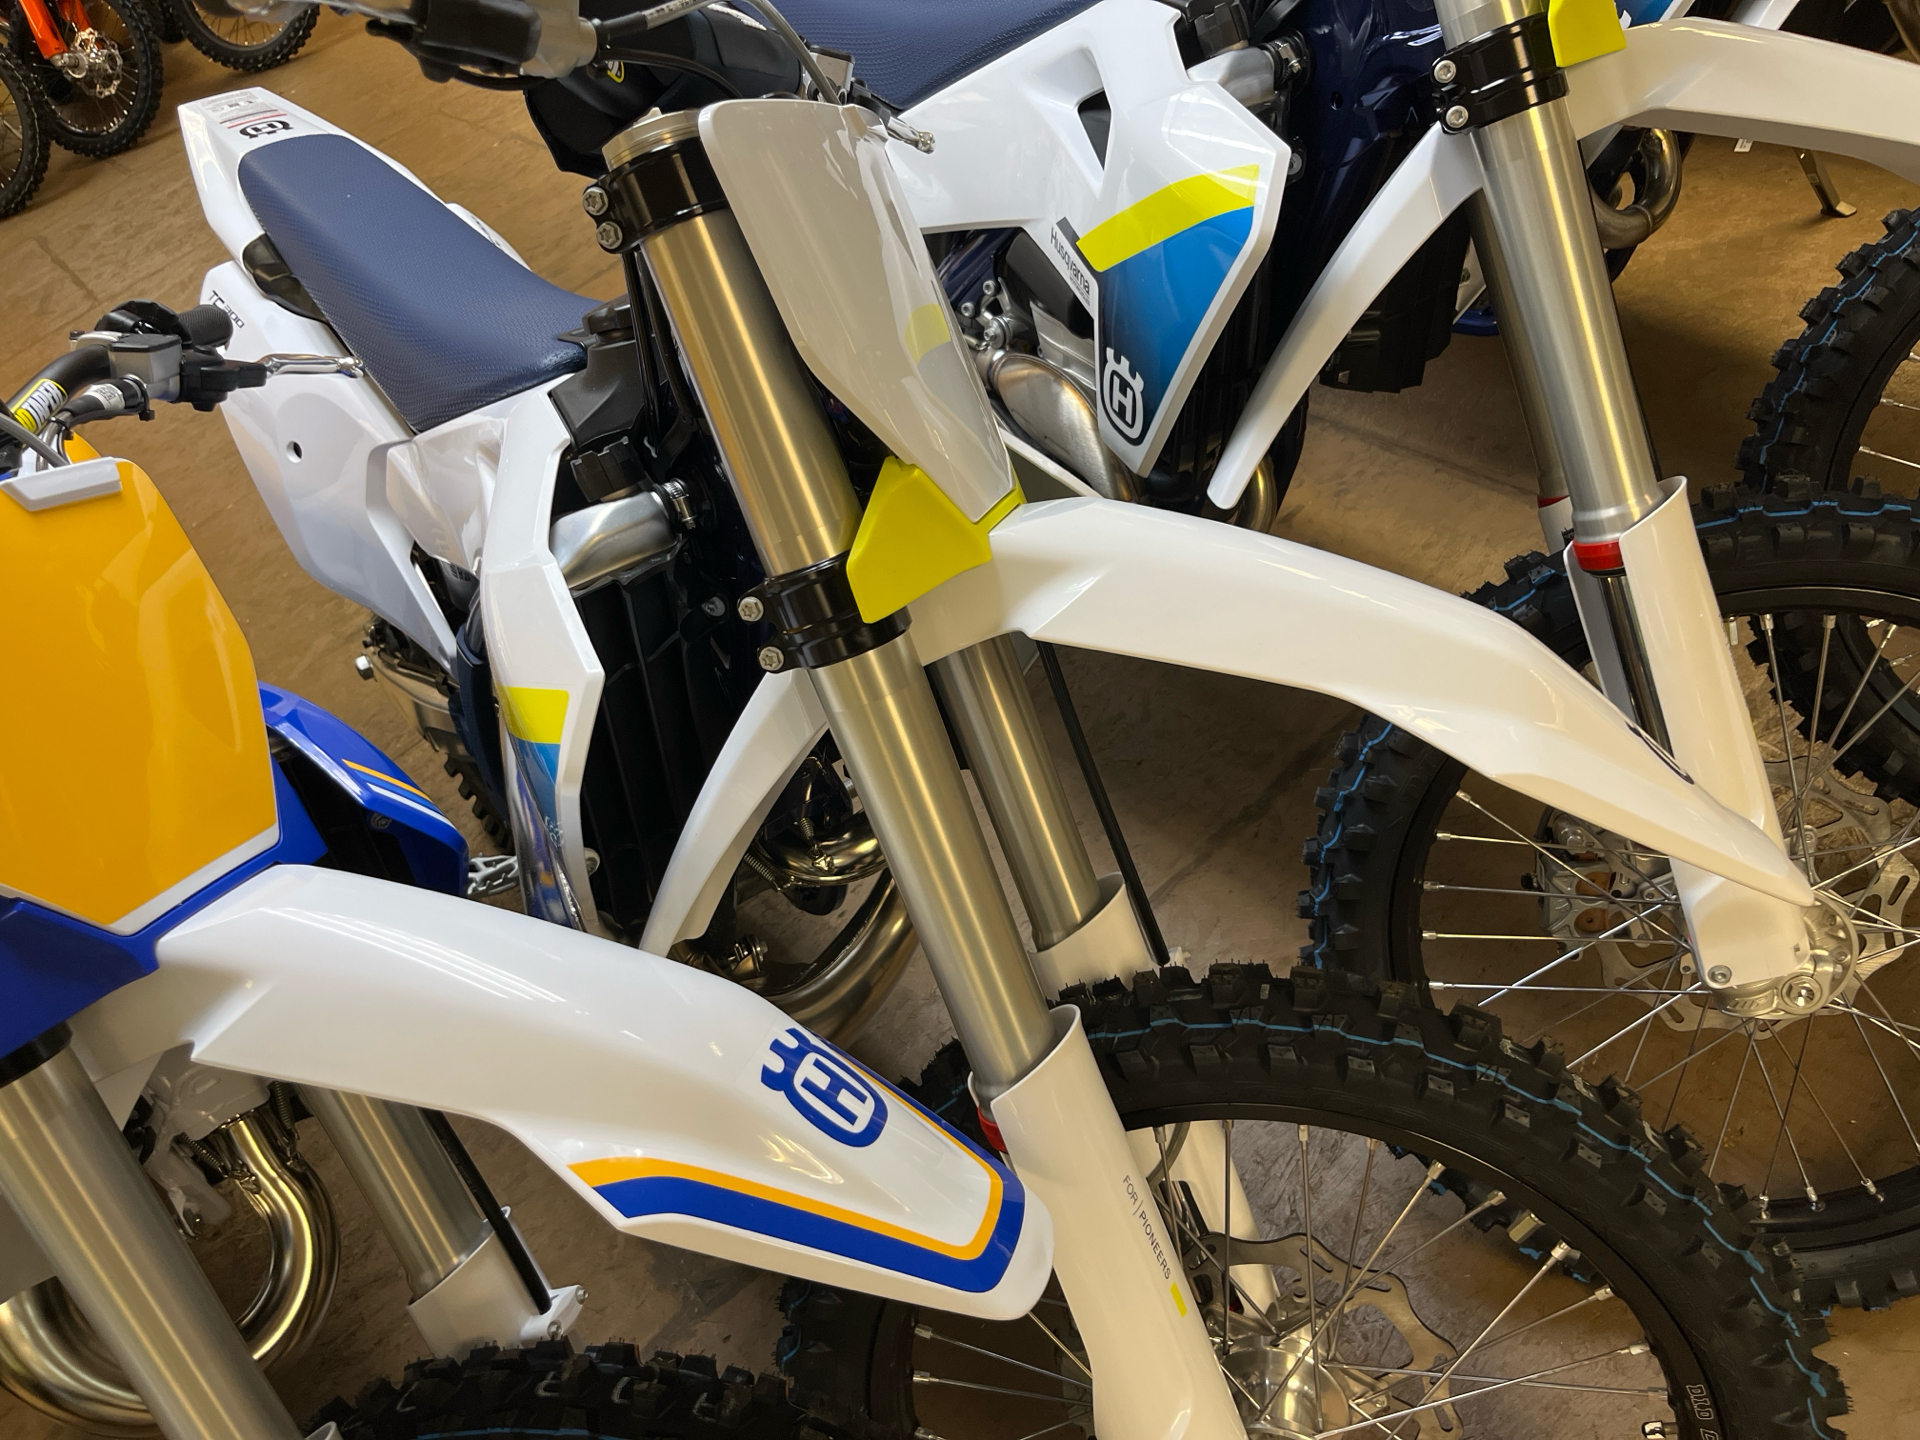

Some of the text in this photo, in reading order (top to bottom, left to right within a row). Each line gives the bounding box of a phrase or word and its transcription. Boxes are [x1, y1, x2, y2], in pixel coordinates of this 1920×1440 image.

[1050, 225, 1090, 296] Husqvarna
[1122, 1174, 1139, 1206] FOR
[1138, 1210, 1172, 1280] PIONEERS
